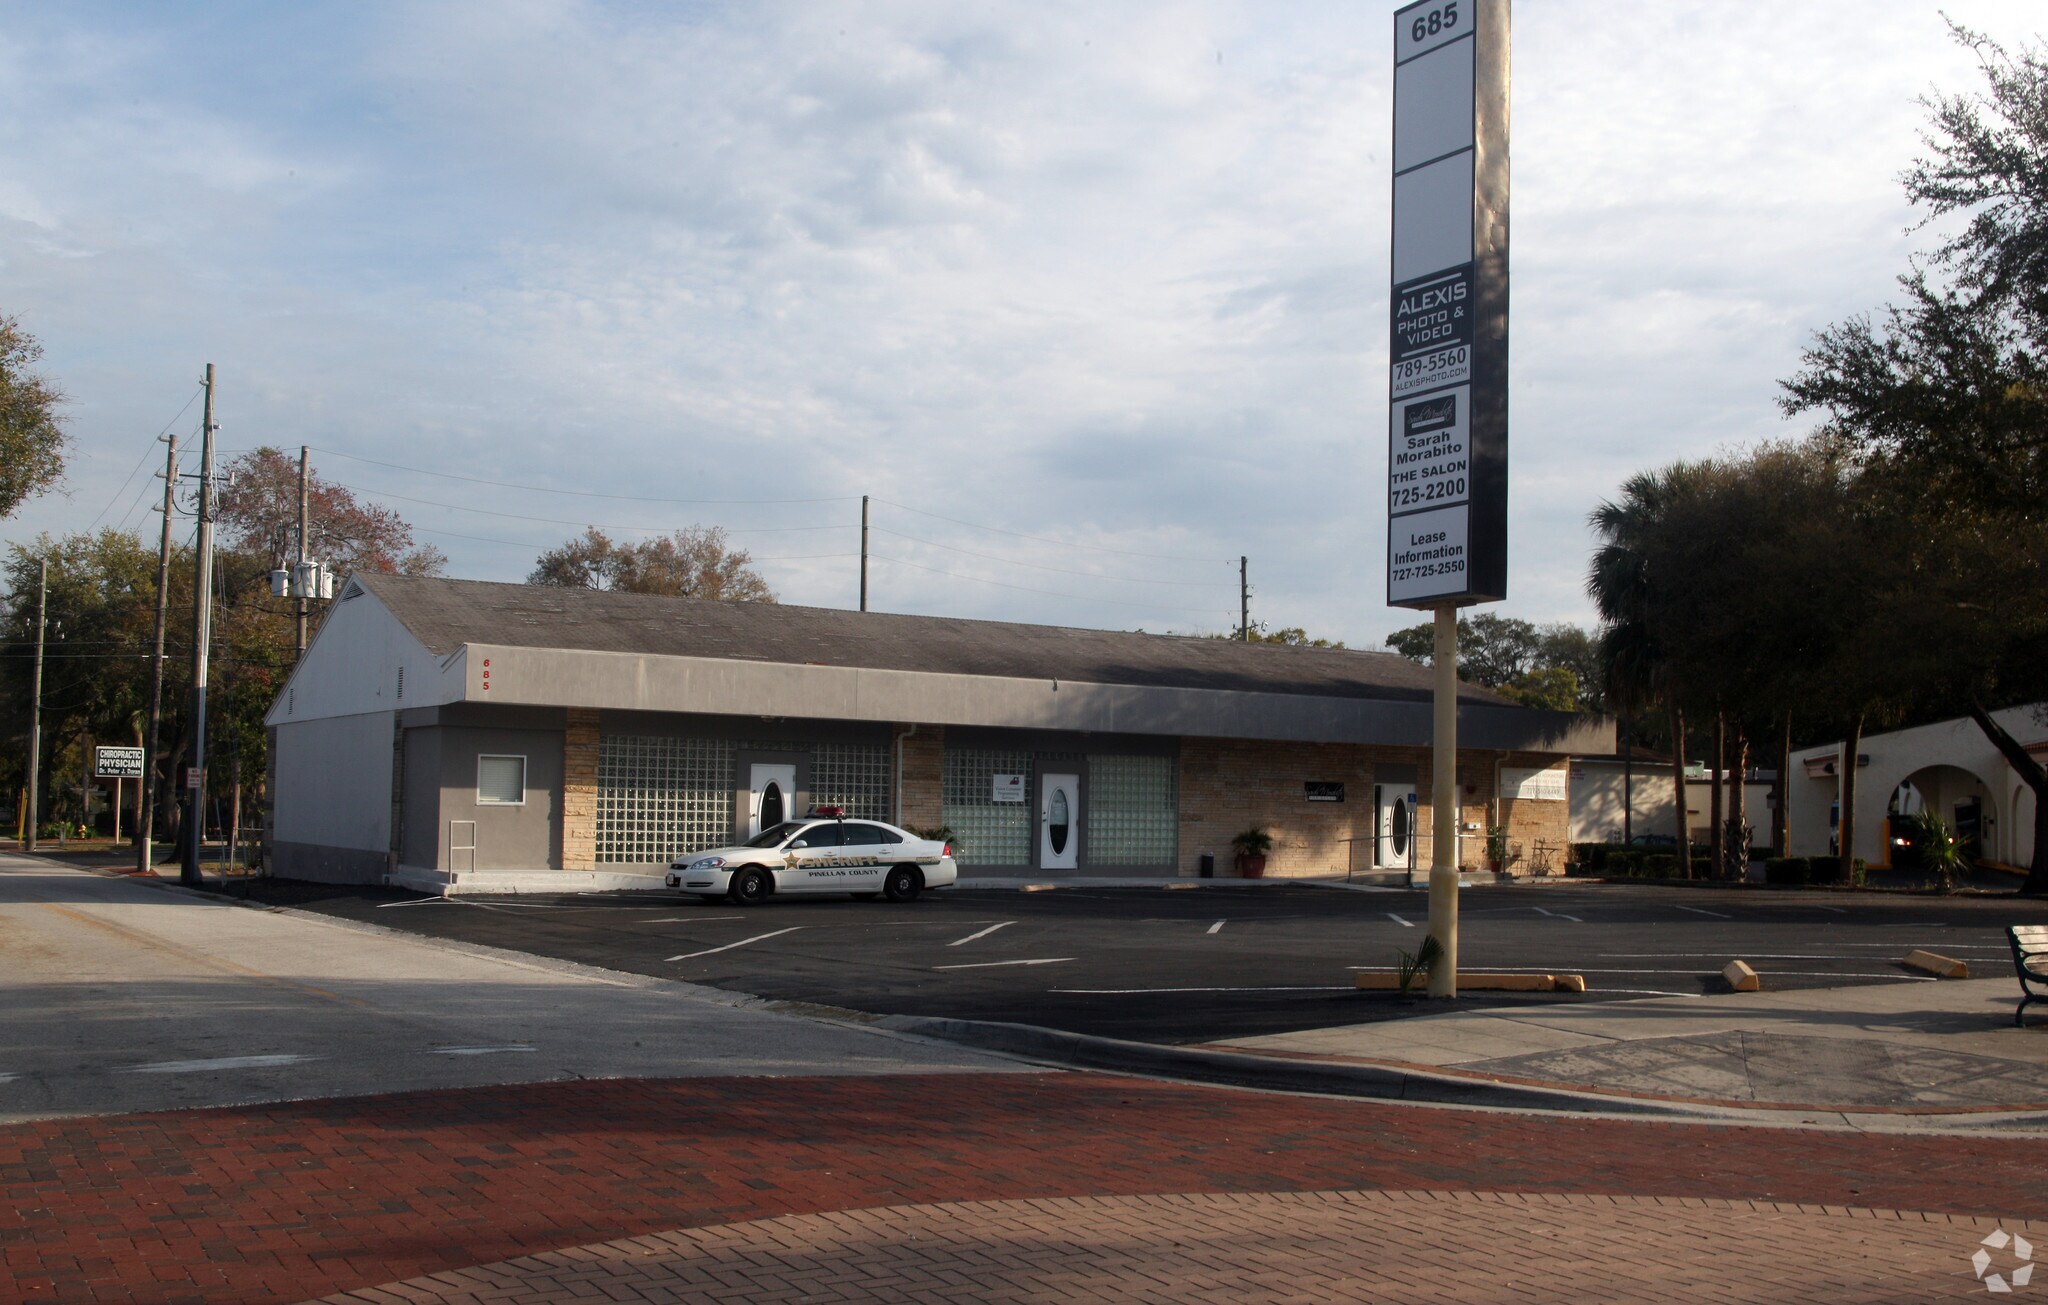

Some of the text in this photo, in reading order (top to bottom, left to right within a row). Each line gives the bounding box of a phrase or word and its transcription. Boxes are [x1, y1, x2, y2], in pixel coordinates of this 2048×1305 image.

[1412, 2, 1457, 42] 685
[1397, 281, 1467, 318] ALEXIS
[1398, 306, 1464, 334] PHOTO &
[1407, 323, 1452, 345] VIDEO
[1396, 347, 1466, 380] 789-5560
[1395, 366, 1467, 391] ALEXISPHOTO.COM
[1407, 431, 1450, 449] Sarah
[1396, 443, 1462, 465] Morabito
[1392, 460, 1466, 484] THE SALON
[1392, 478, 1465, 507] 725-2200
[1411, 531, 1446, 546] Lease
[1395, 545, 1463, 565] Information
[1393, 560, 1465, 581] 727-725-2550
[99, 759, 141, 768] PHYSICIAN
[100, 750, 141, 759] CHIROPRACTIC
[802, 856, 879, 868] SHERIFF
